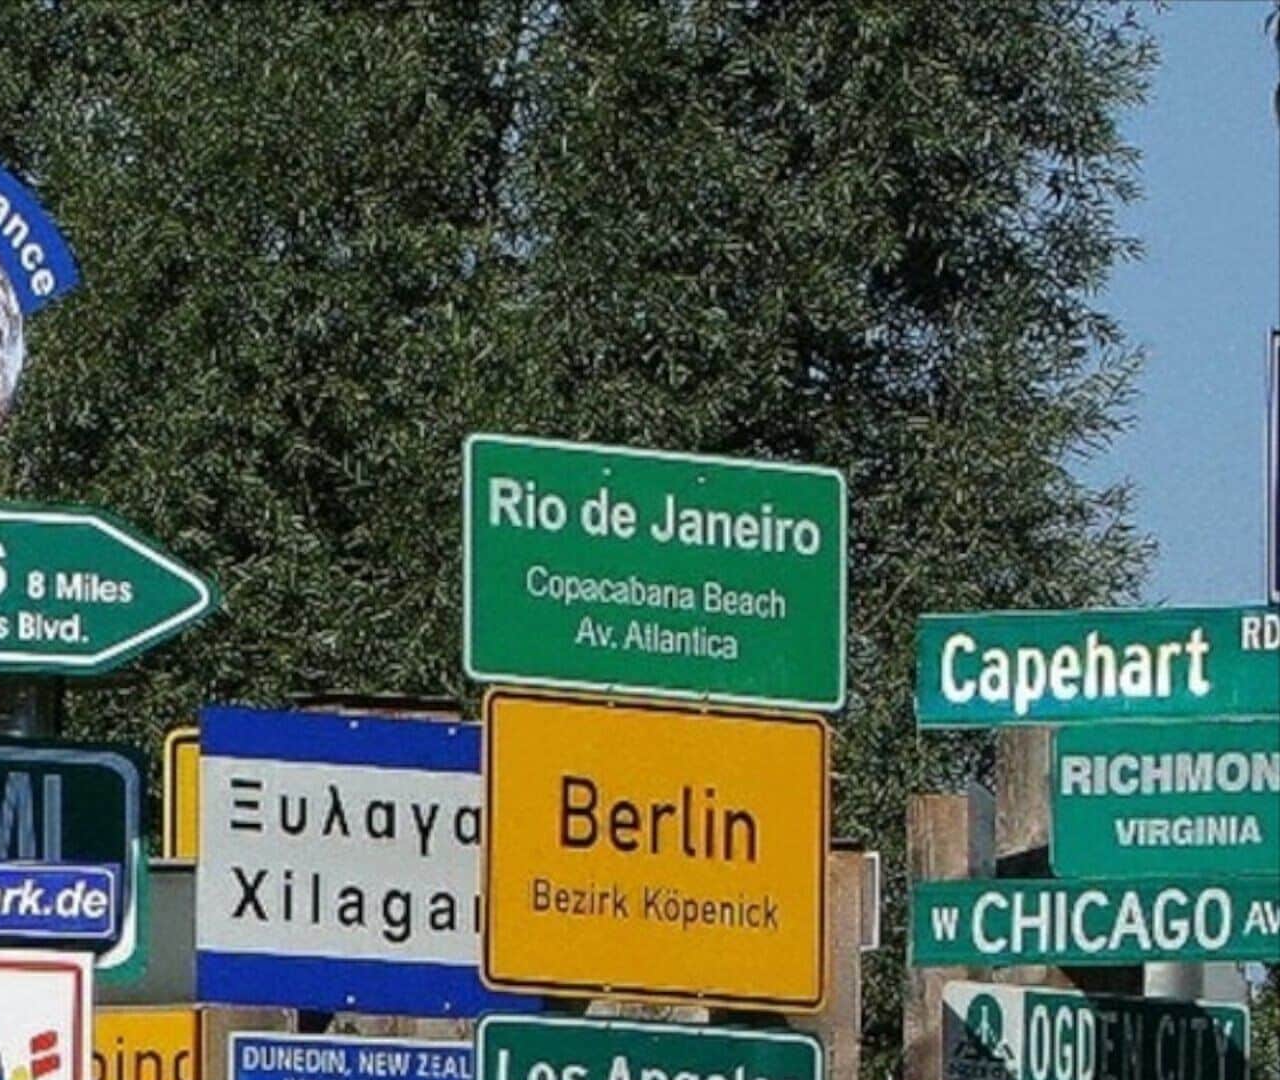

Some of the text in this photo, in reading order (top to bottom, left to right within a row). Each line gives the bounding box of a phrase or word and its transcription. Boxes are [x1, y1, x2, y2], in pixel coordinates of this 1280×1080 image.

[489, 477, 821, 556] Rio de Janeiro
[27, 571, 46, 598] 8
[55, 572, 133, 603] Miles
[527, 565, 786, 619] Copacabana Beach
[17, 612, 89, 643] Blvd.
[576, 618, 738, 660] Av. Atlantica
[941, 615, 1280, 715] Capehart RD
[561, 775, 757, 863] Berlin
[1115, 817, 1261, 847] VIRGINIA
[533, 878, 778, 931] Bezirk Köpenick
[932, 907, 959, 942] W
[972, 889, 1231, 953] CHICAGO
[242, 1045, 410, 1076] DUNEDIN, NEW
